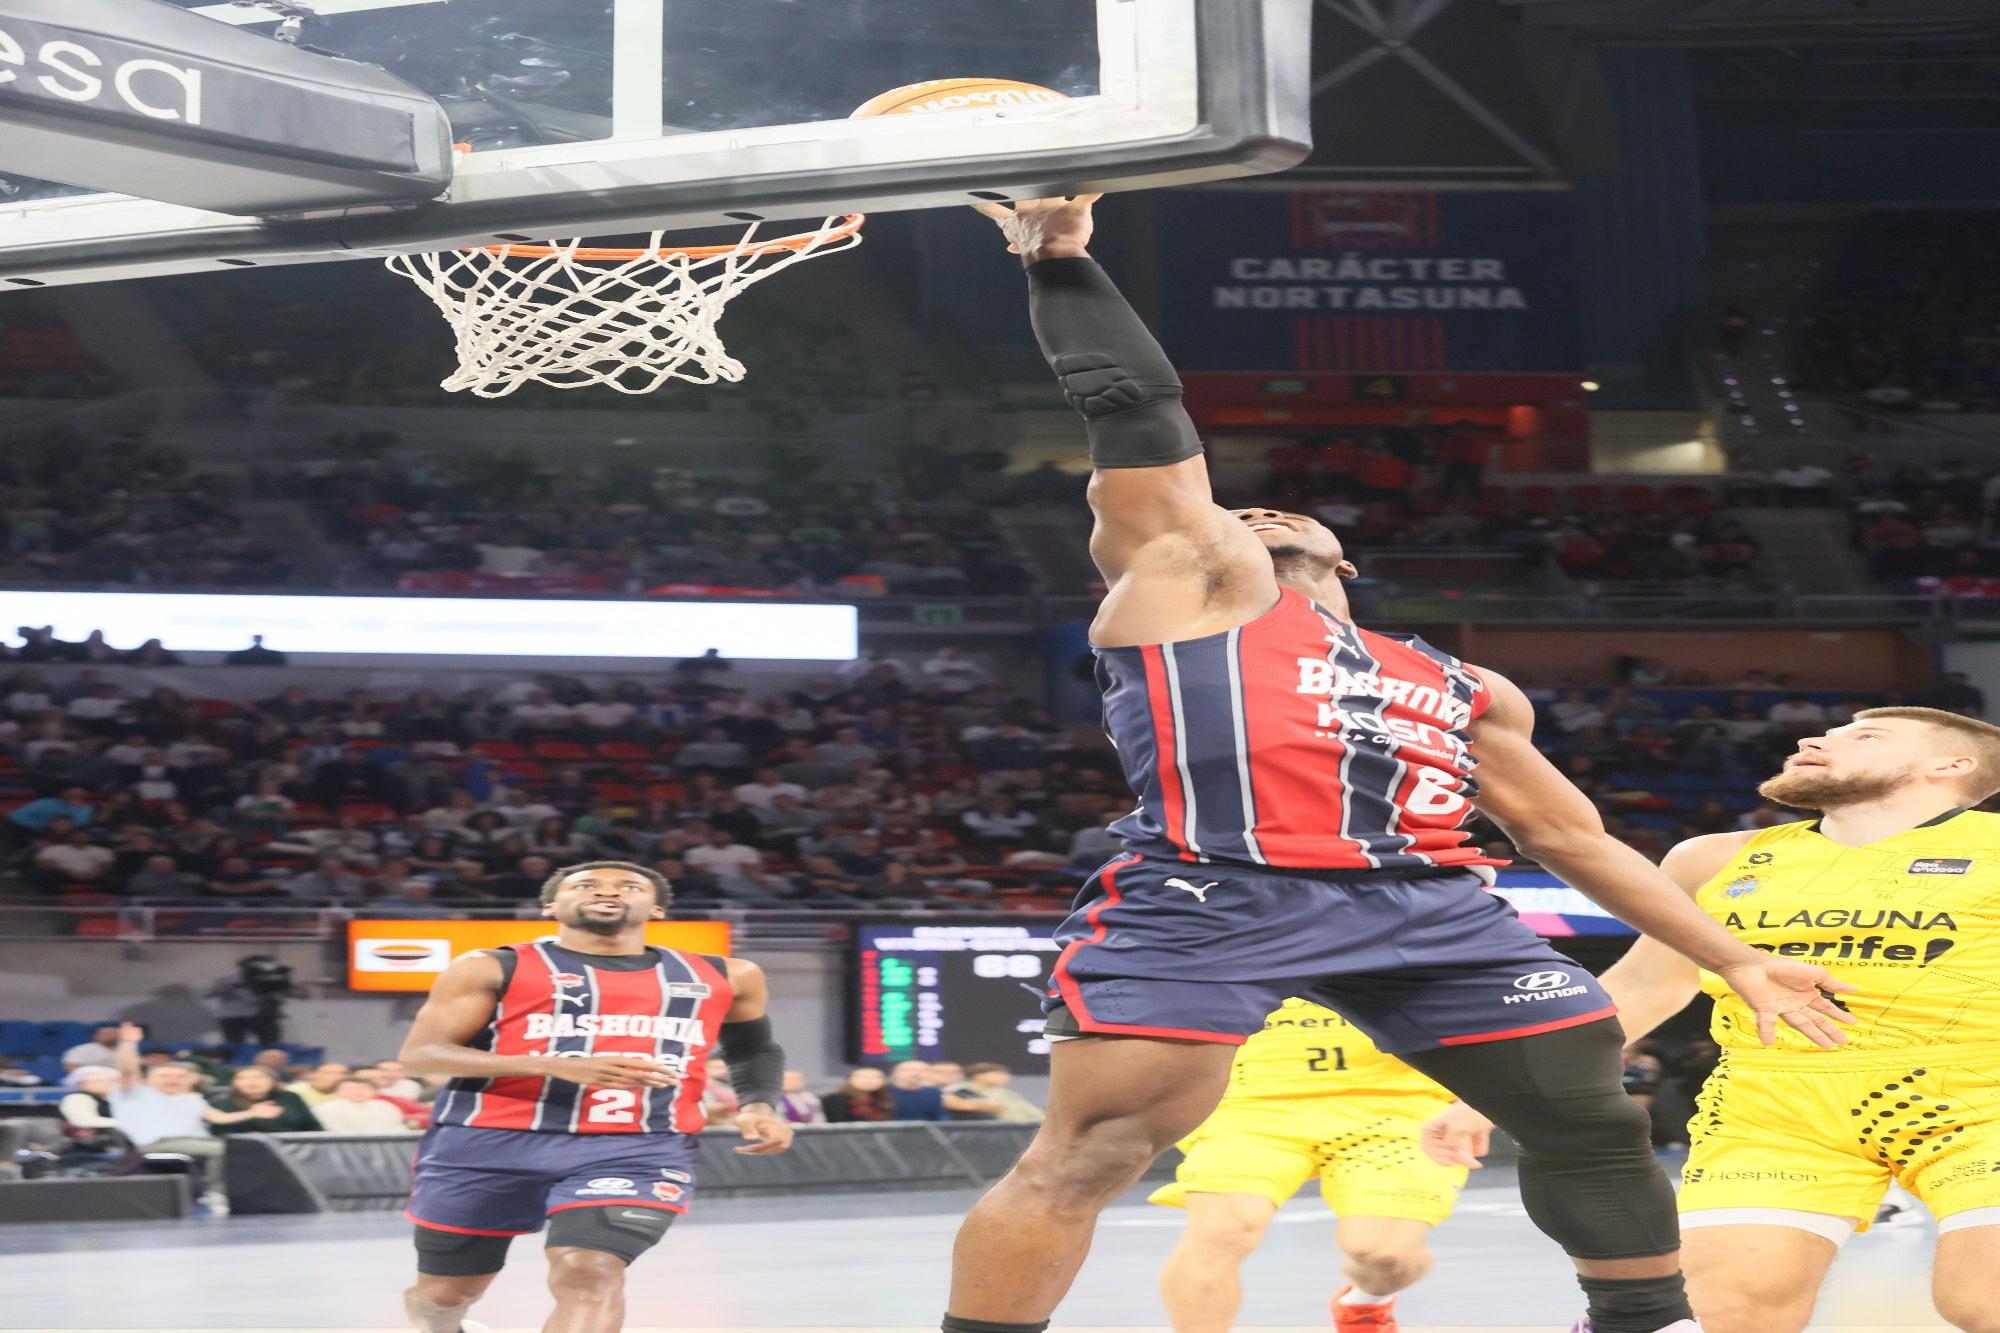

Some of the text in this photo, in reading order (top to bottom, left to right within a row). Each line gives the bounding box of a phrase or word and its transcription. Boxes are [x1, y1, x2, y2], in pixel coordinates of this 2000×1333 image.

[1231, 252, 1504, 281] CARÁCTER
[1213, 286, 1528, 309] NORTASUNA
[1757, 909, 1958, 931] LAGUNA
[1502, 985, 1589, 1005] HYUNDAI
[1306, 1046, 1348, 1072] 21
[587, 1088, 636, 1124] 2
